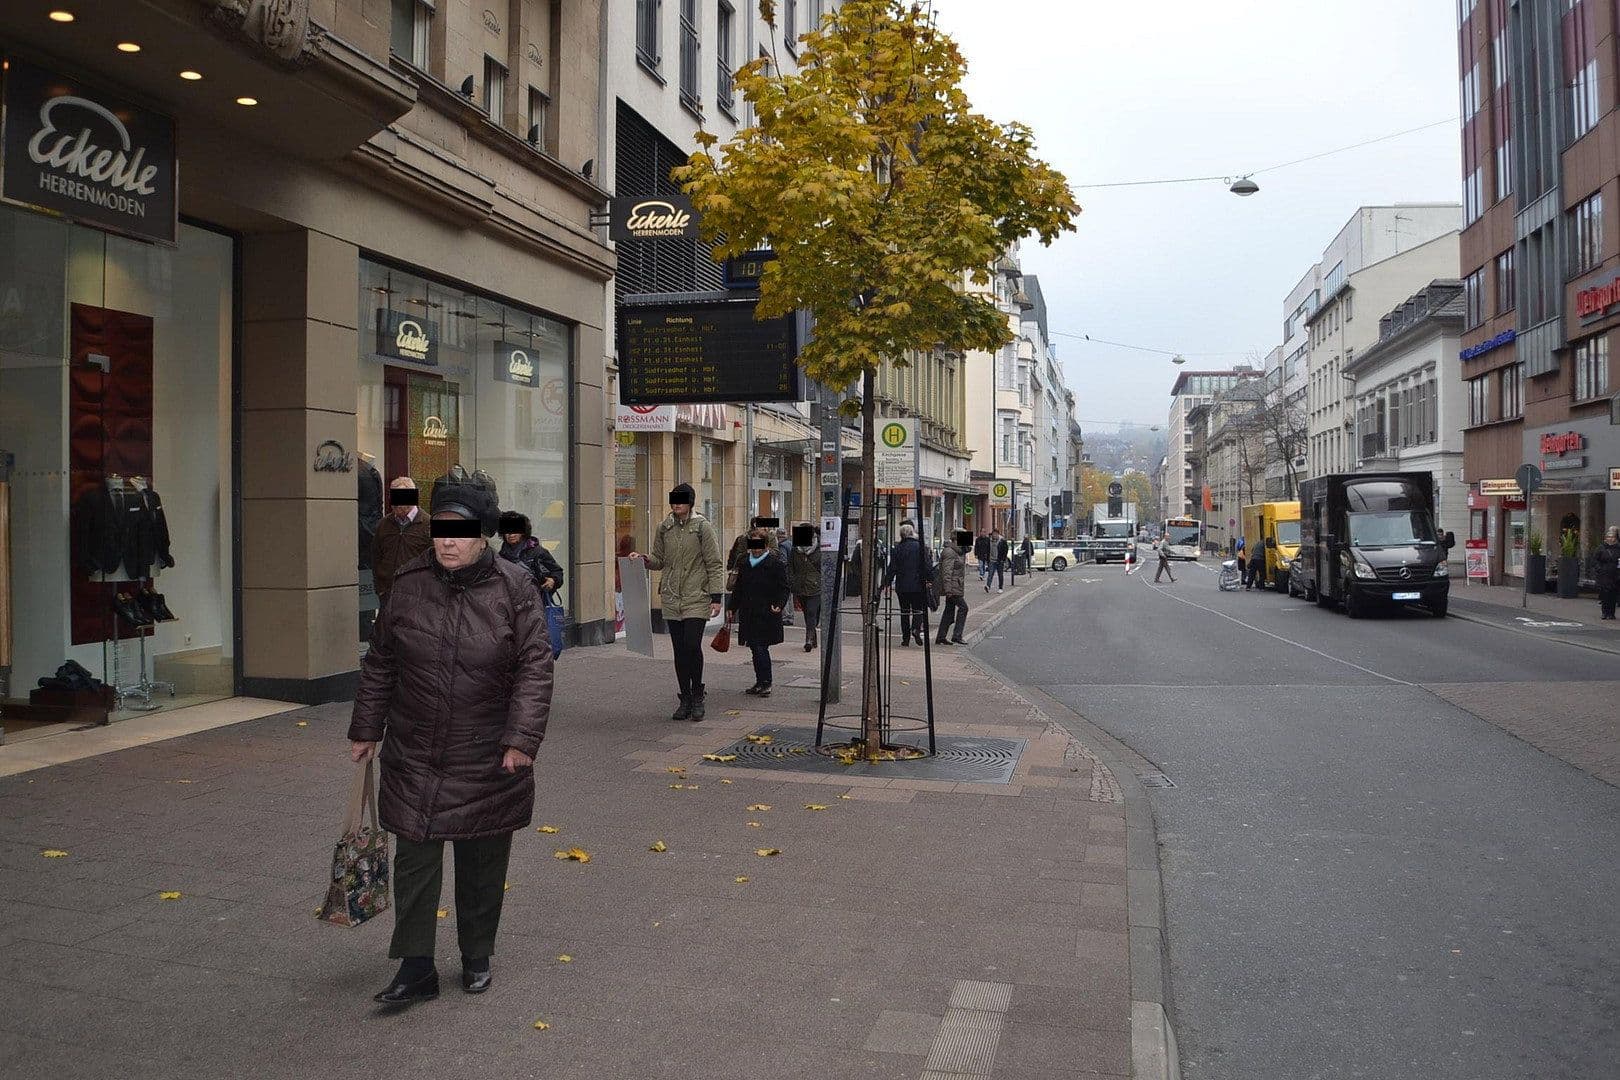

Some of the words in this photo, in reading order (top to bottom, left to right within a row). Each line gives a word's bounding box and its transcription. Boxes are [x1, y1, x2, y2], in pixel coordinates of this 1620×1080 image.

[29, 96, 157, 195] Eckerle
[39, 172, 145, 217] HERRENMODEN
[627, 201, 690, 230] Eckerle
[633, 229, 683, 237] HERRENMODEN
[666, 317, 693, 325] Richtung
[617, 415, 669, 424] ROSSMANN
